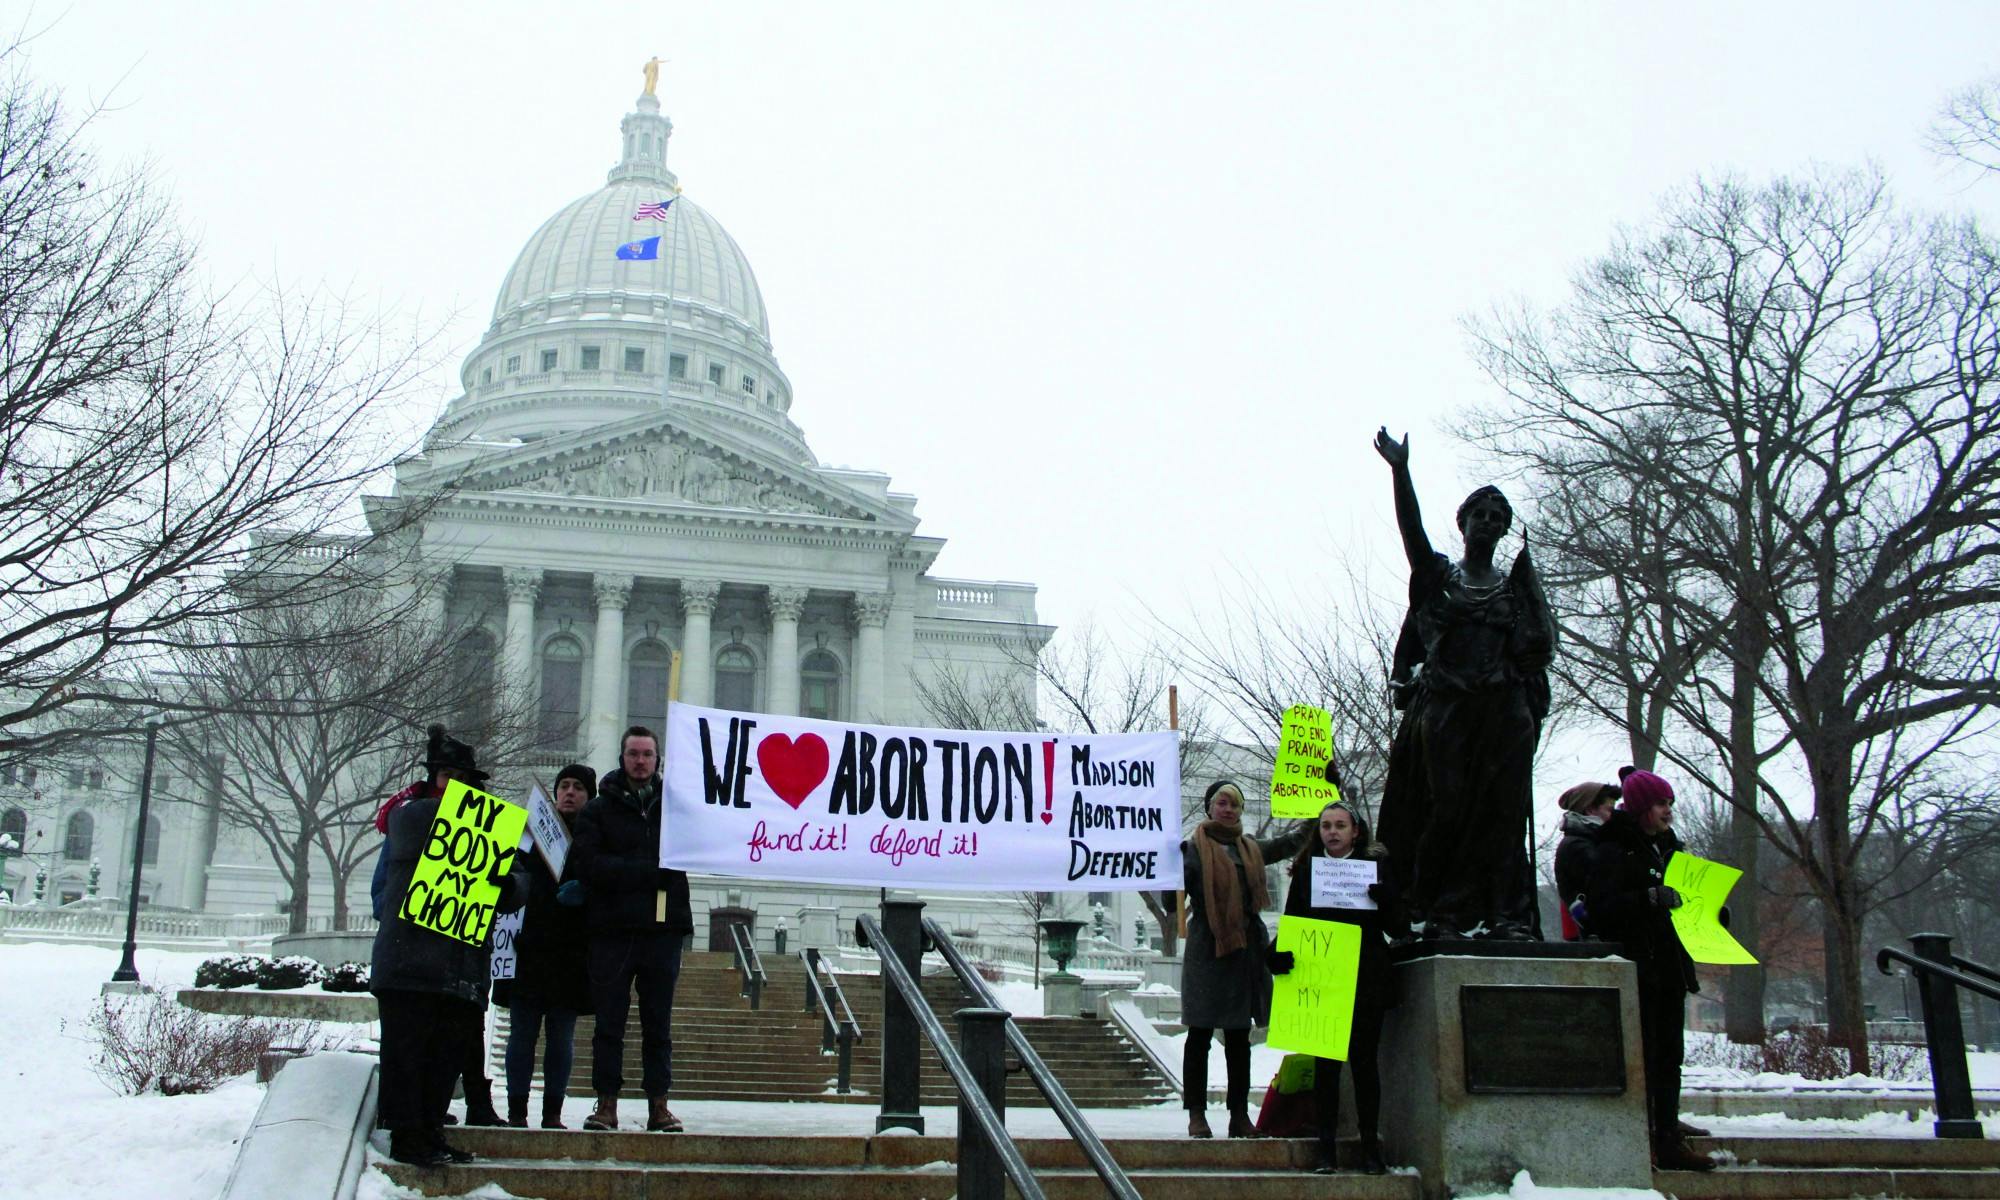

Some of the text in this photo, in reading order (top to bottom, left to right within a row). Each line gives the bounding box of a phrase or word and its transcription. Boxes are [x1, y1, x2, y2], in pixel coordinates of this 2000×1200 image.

[1293, 705, 1322, 725] PRAY
[1290, 725, 1327, 742] TO END
[1287, 740, 1329, 762] PRAYING
[698, 717, 1056, 825] WE ABORTION!
[1071, 744, 1155, 788] MADISON
[1285, 763, 1324, 779] TO END
[1273, 783, 1333, 799] ABORTION
[456, 790, 505, 833] MY
[1069, 791, 1163, 838] ABORTION
[423, 818, 516, 885] BODY
[747, 820, 978, 867] fund it! defend it!
[1067, 840, 1158, 881] DEFENSE
[1322, 861, 1351, 869] Solidarity
[435, 868, 478, 898] MY
[403, 880, 494, 946] CHOICE
[1300, 929, 1333, 958] MY
[1296, 960, 1336, 985] ODY
[1298, 987, 1321, 1009] MY
